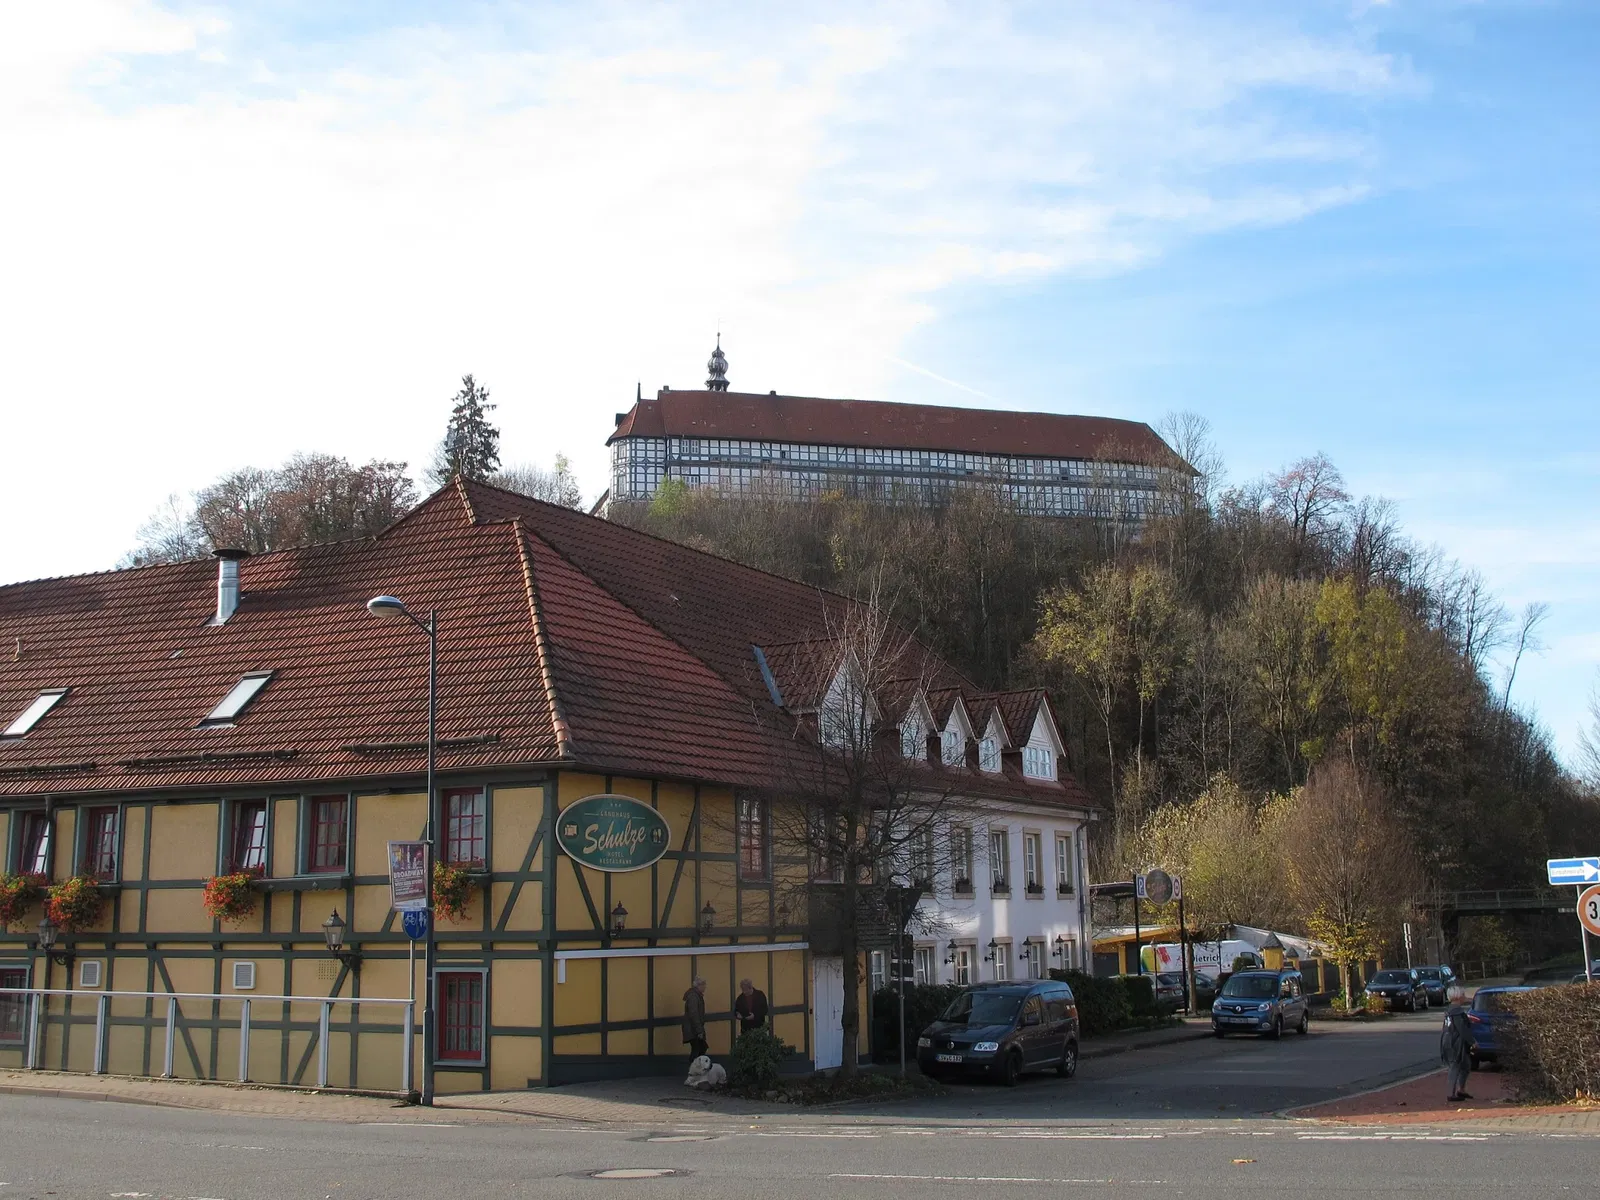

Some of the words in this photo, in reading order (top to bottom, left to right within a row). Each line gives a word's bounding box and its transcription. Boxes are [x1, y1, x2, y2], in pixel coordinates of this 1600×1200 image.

[600, 810, 631, 819] LANDHAUS
[583, 819, 647, 855] Schulze
[394, 869, 424, 879] BROADWAY
